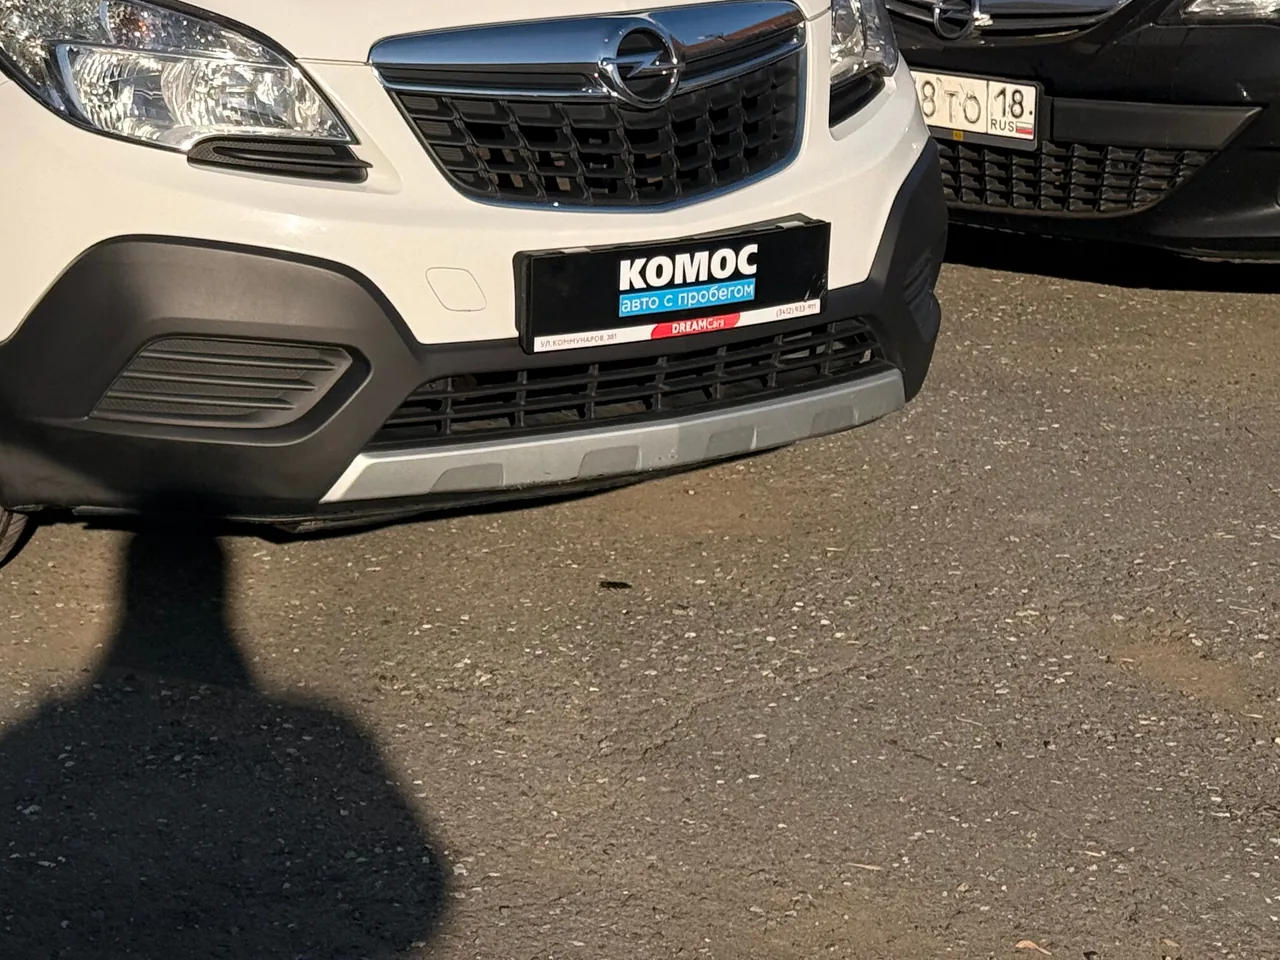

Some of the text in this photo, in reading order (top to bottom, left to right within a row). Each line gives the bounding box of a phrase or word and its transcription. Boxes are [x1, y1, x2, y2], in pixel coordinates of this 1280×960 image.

[993, 87, 1024, 119] 18
[990, 118, 1015, 132] RUS
[619, 243, 758, 290] КОМОС
[621, 281, 754, 313] авто с пробегом
